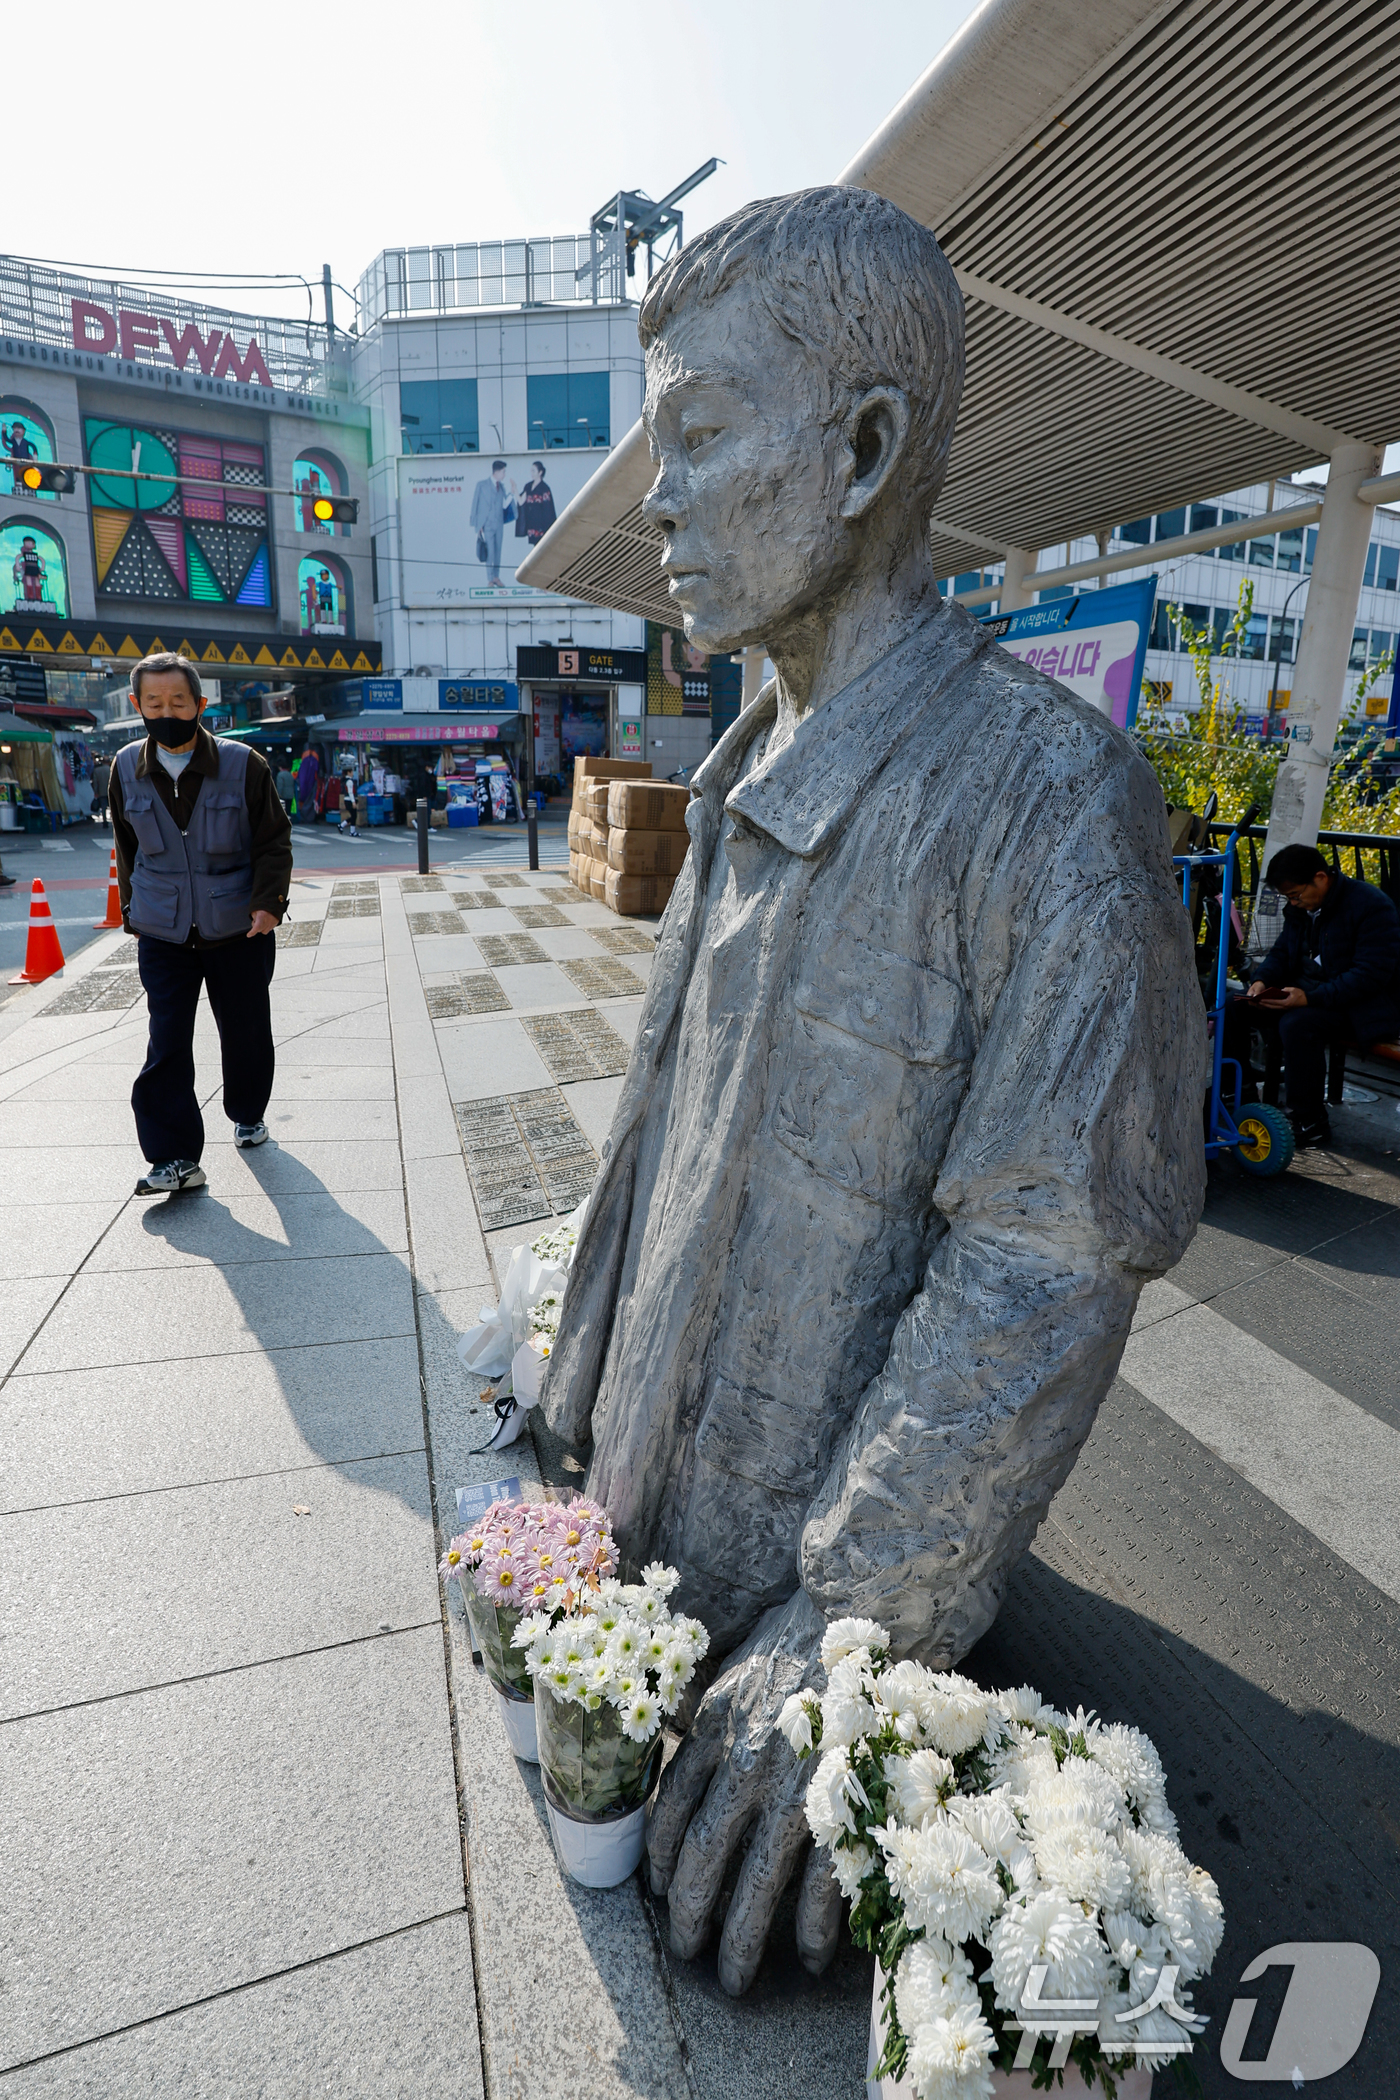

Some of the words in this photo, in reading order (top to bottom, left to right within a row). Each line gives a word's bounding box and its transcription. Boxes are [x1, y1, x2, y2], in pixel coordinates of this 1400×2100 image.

[71, 298, 273, 388] DFWM
[0, 340, 105, 373] ONGDAEMUN
[116, 362, 182, 388] FASHION
[193, 378, 276, 405] WHOLESALE
[287, 396, 339, 417] MARKET
[1019, 608, 1061, 629] 시작합니다
[564, 655, 573, 670] 5
[589, 655, 613, 666] GATE
[445, 686, 505, 704] 송월타올
[444, 726, 490, 739] 송월타올
